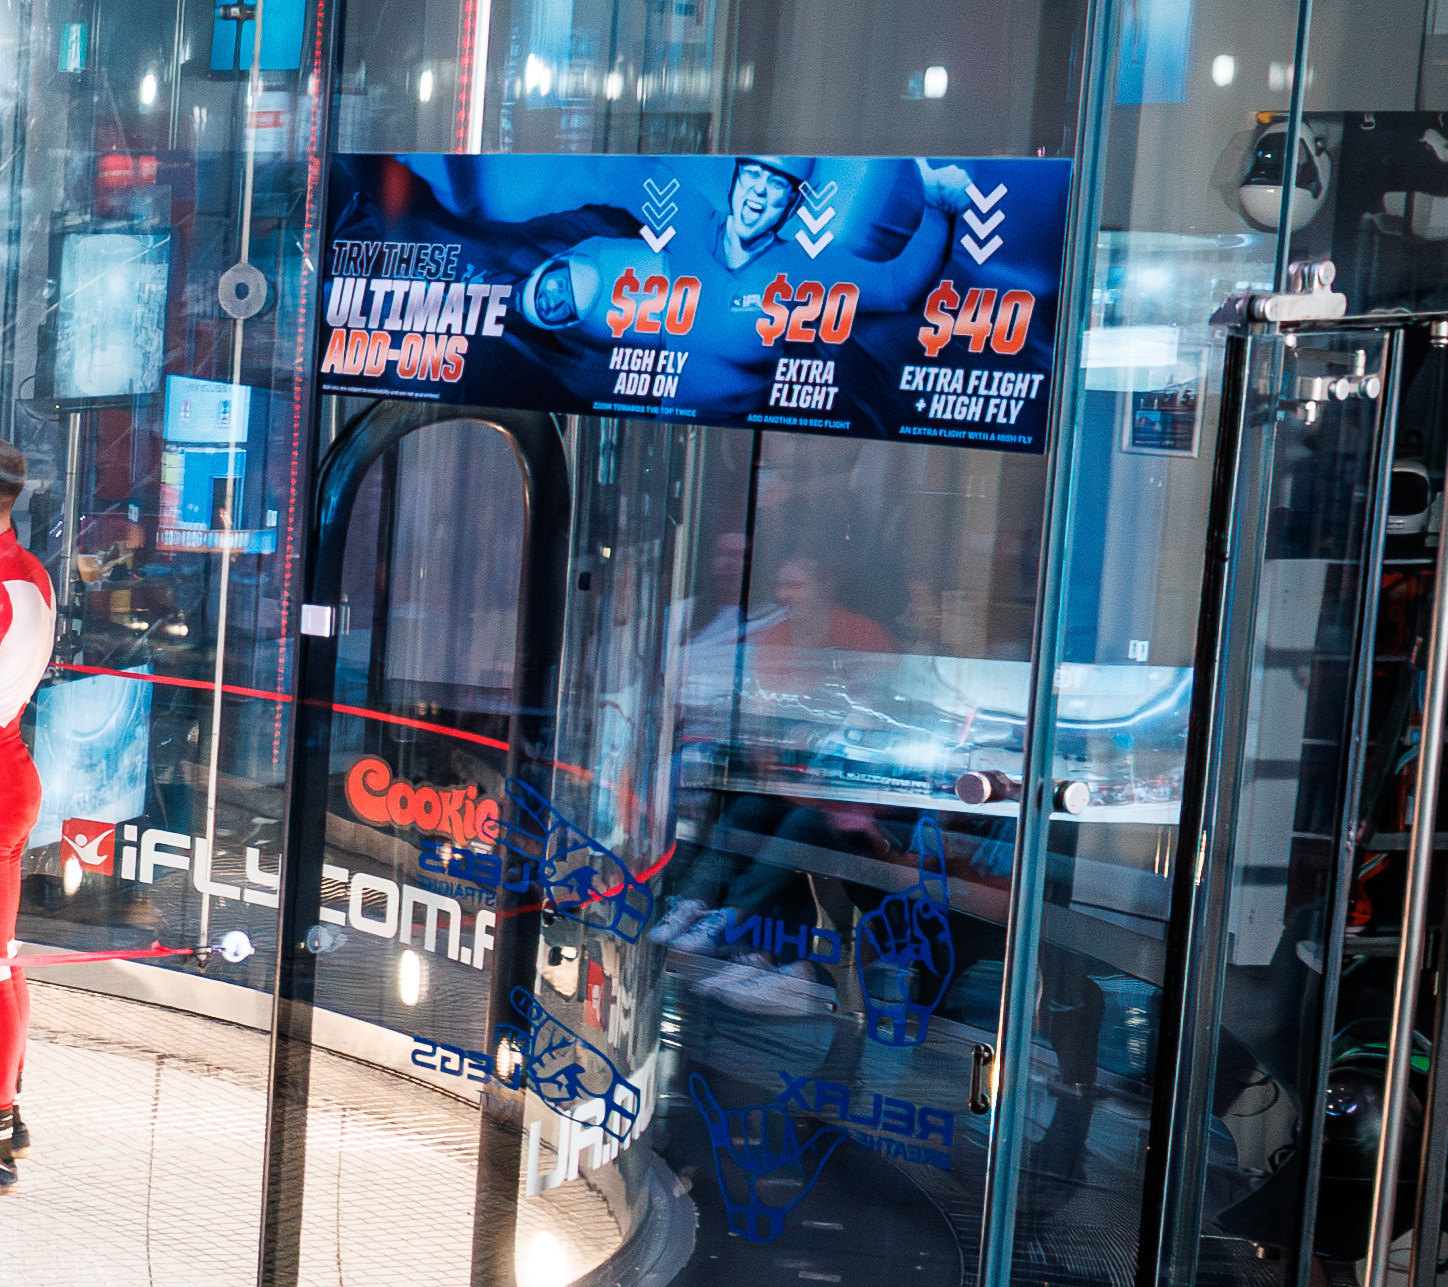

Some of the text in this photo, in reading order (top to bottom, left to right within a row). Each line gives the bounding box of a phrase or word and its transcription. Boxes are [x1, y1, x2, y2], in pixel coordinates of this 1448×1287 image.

[332, 240, 462, 281] TRY THESE
[326, 277, 513, 336] ULTIMATE
[606, 268, 702, 338] $20
[756, 273, 860, 346] $20
[918, 279, 1036, 357] $40
[321, 328, 469, 383] ADD-ONS
[609, 347, 689, 374] HIGH FLY
[774, 358, 835, 384] EXTRA
[613, 372, 679, 398] ADD ON
[769, 383, 839, 410] FLIGHT
[899, 365, 1045, 399] EXTRA FLIGHT
[824, 420, 851, 429] FLIGHT
[929, 394, 984, 422] HIGH
[985, 398, 1024, 424] FLY
[912, 427, 938, 436] EXTRA
[939, 429, 966, 439] FLIGHT
[968, 431, 989, 440] WITH
